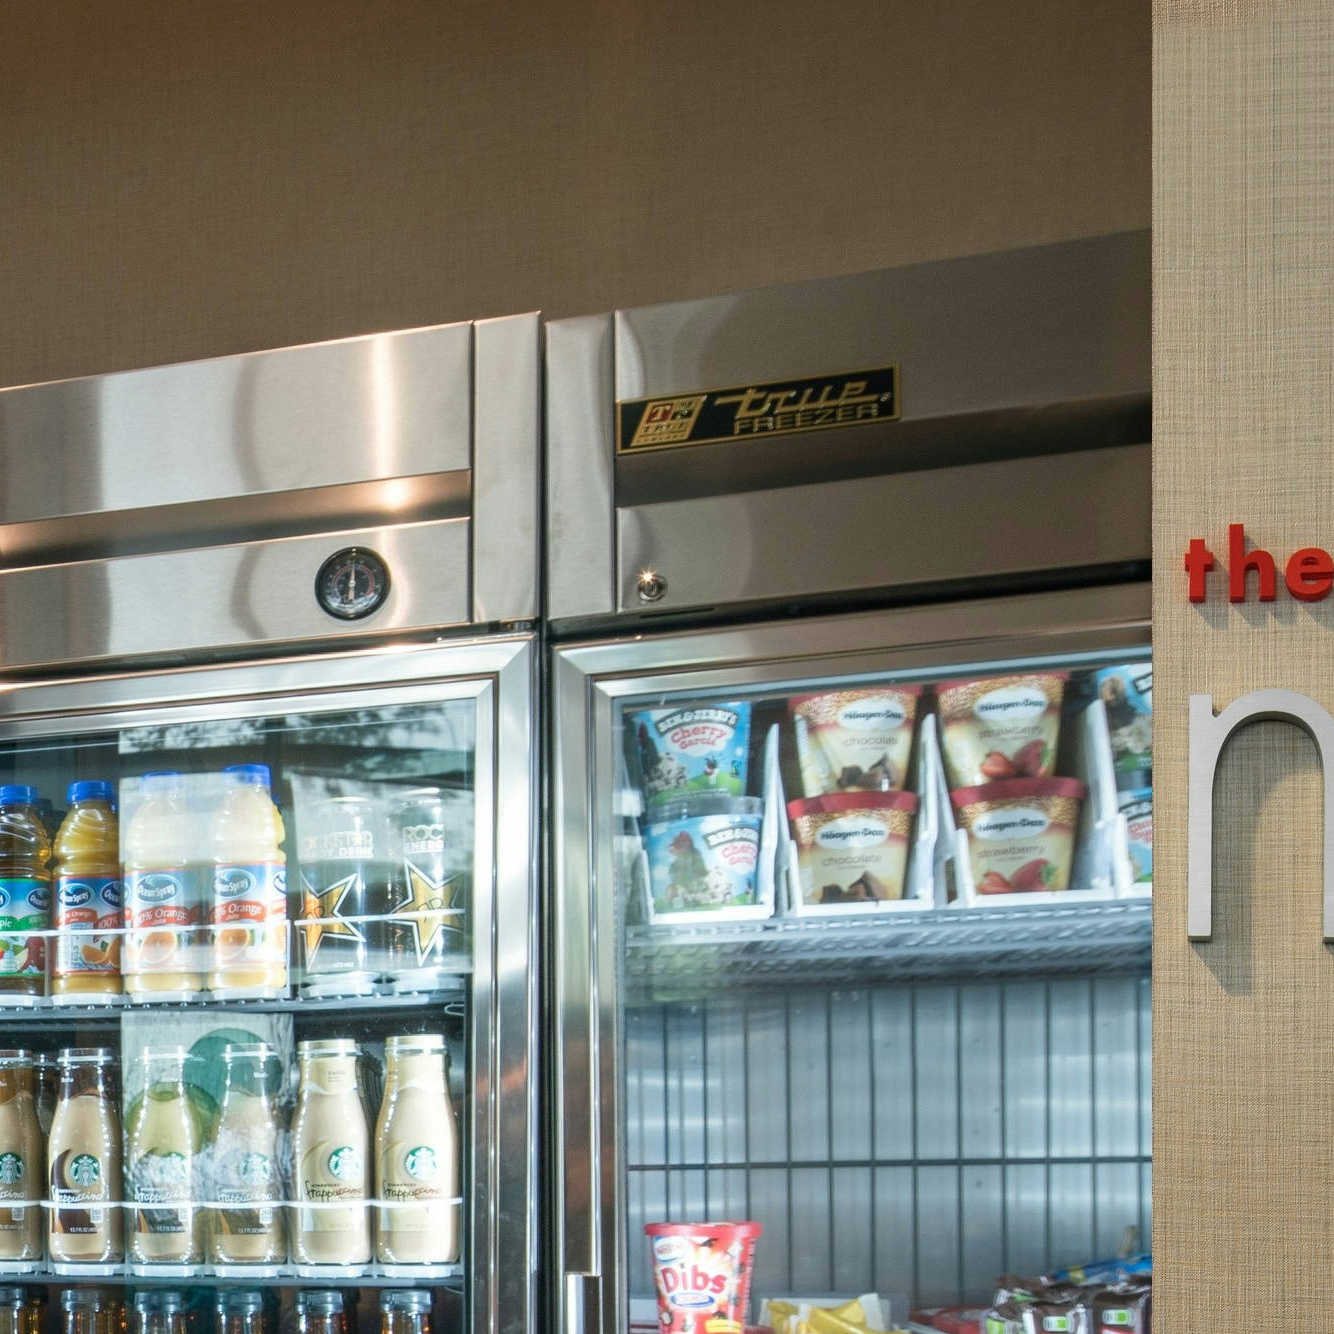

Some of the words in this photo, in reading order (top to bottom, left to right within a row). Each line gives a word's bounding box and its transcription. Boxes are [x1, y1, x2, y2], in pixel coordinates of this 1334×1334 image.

[734, 403, 879, 434] FREEZER
[1185, 523, 1334, 602] the
[155, 908, 187, 921] Orange
[228, 902, 262, 915] Orange
[661, 1262, 727, 1295] Dibs
